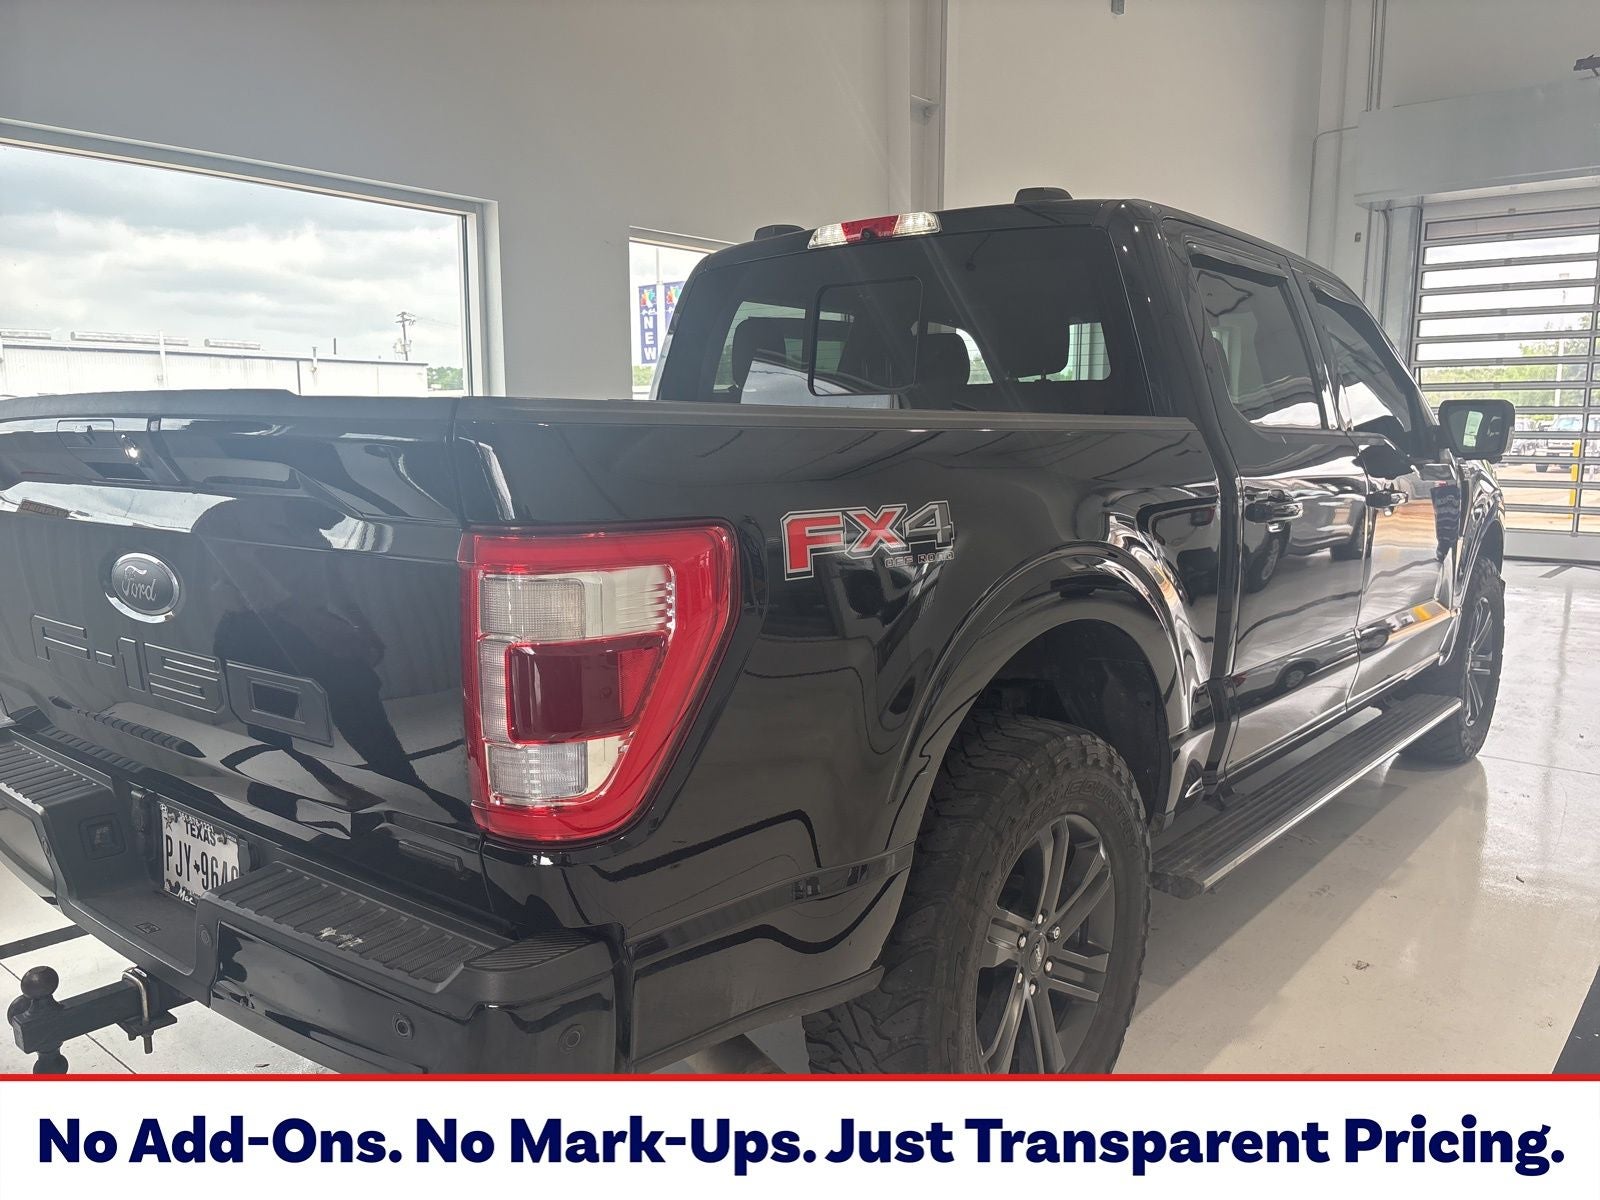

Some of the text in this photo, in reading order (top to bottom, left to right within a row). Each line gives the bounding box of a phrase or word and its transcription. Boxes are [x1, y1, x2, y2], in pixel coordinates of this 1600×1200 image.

[643, 316, 656, 360] NEW
[780, 500, 955, 581] FX4
[884, 551, 955, 568] OFF ROAD
[121, 565, 157, 602] Ford
[31, 614, 334, 747] F-150
[184, 820, 216, 847] TEXAS
[165, 834, 192, 881] PJY
